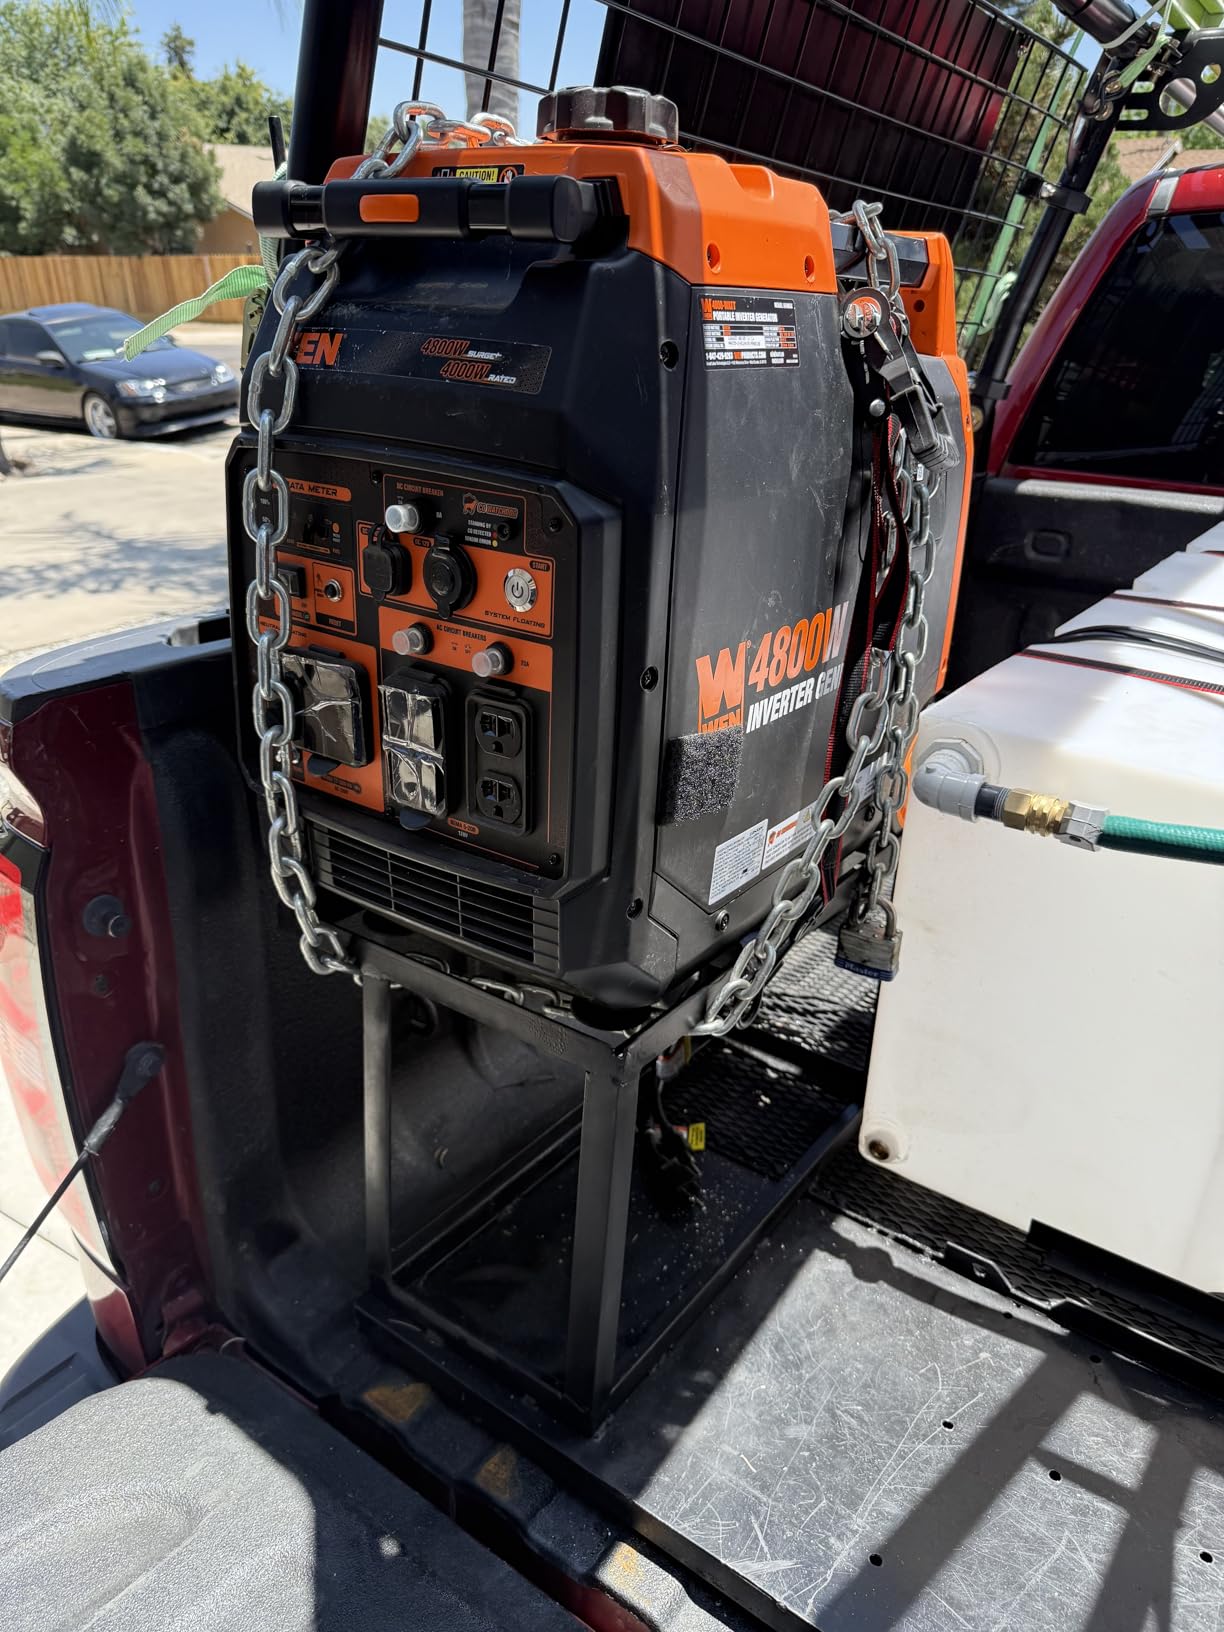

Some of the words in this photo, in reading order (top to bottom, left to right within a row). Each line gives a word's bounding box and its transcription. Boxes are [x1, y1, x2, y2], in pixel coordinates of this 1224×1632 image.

[459, 169, 495, 181] CAUTION!
[294, 332, 344, 366] EN
[420, 337, 470, 357] 4800W
[440, 360, 492, 382] 4000W
[488, 373, 517, 384] RATED
[287, 482, 305, 491] ATA
[308, 485, 338, 497] METER
[422, 486, 444, 497] BREAKER
[532, 562, 550, 571] START
[484, 610, 512, 622] SYSTEM
[512, 615, 546, 629] FLOATING
[443, 625, 462, 636] CIRCUIT
[462, 628, 487, 642] BREAKERS
[748, 600, 849, 693] 4800W
[745, 677, 816, 734] INVERTER
[843, 961, 881, 977] Master
